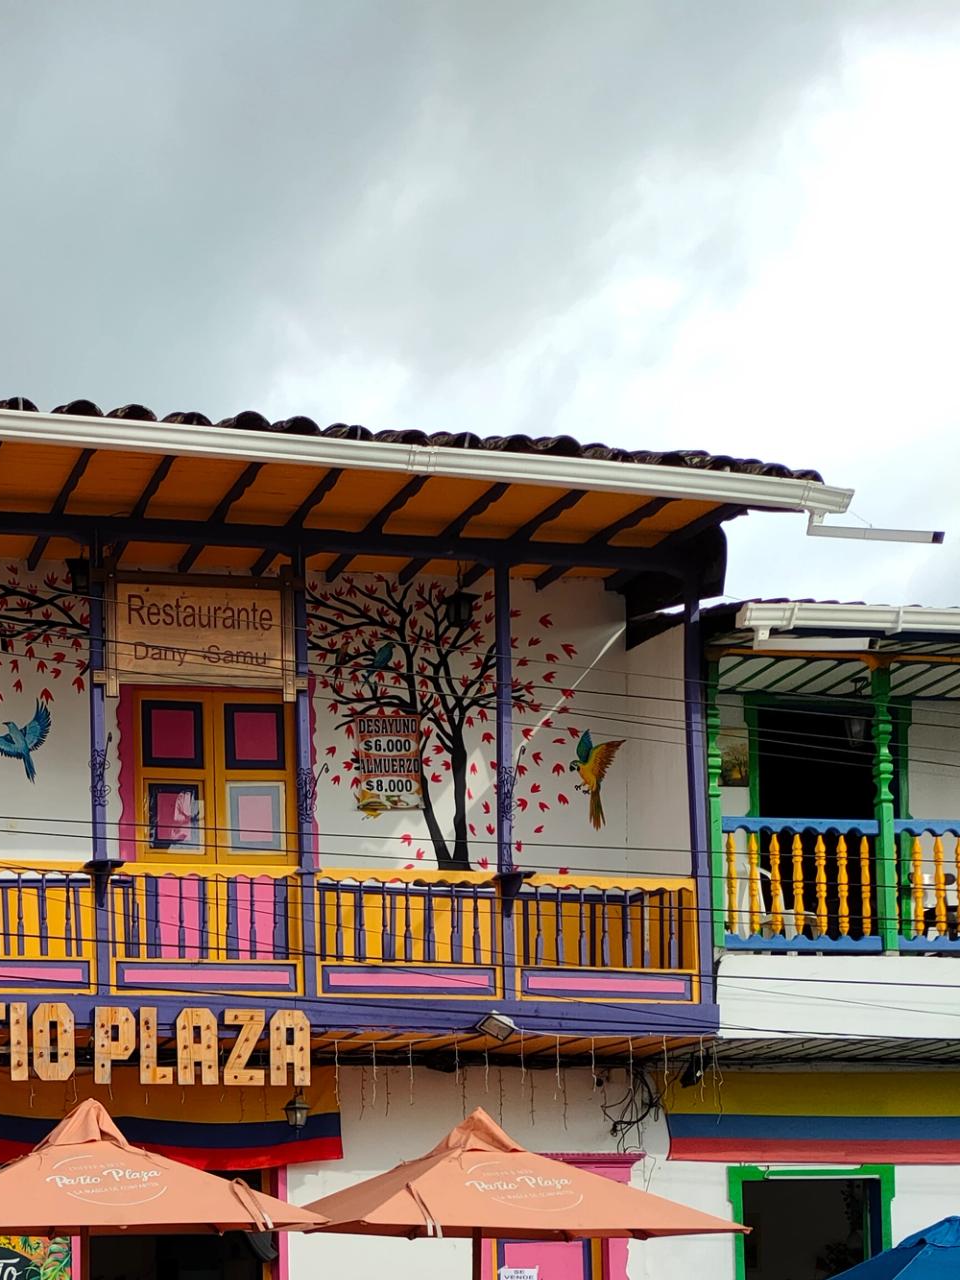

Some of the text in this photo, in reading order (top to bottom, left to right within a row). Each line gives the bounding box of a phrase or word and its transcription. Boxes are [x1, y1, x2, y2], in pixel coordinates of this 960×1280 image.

[127, 593, 273, 631] Restaurante
[134, 641, 187, 666] Dany
[358, 718, 417, 734] DESAYUNO
[363, 739, 411, 752] $6.000
[360, 758, 420, 774] ALMUERZO
[365, 779, 412, 792] $8.000
[94, 1005, 311, 1087] PLAZA
[46, 1168, 161, 1187] Patio Plaza
[464, 1175, 572, 1192] Patio Plaza
